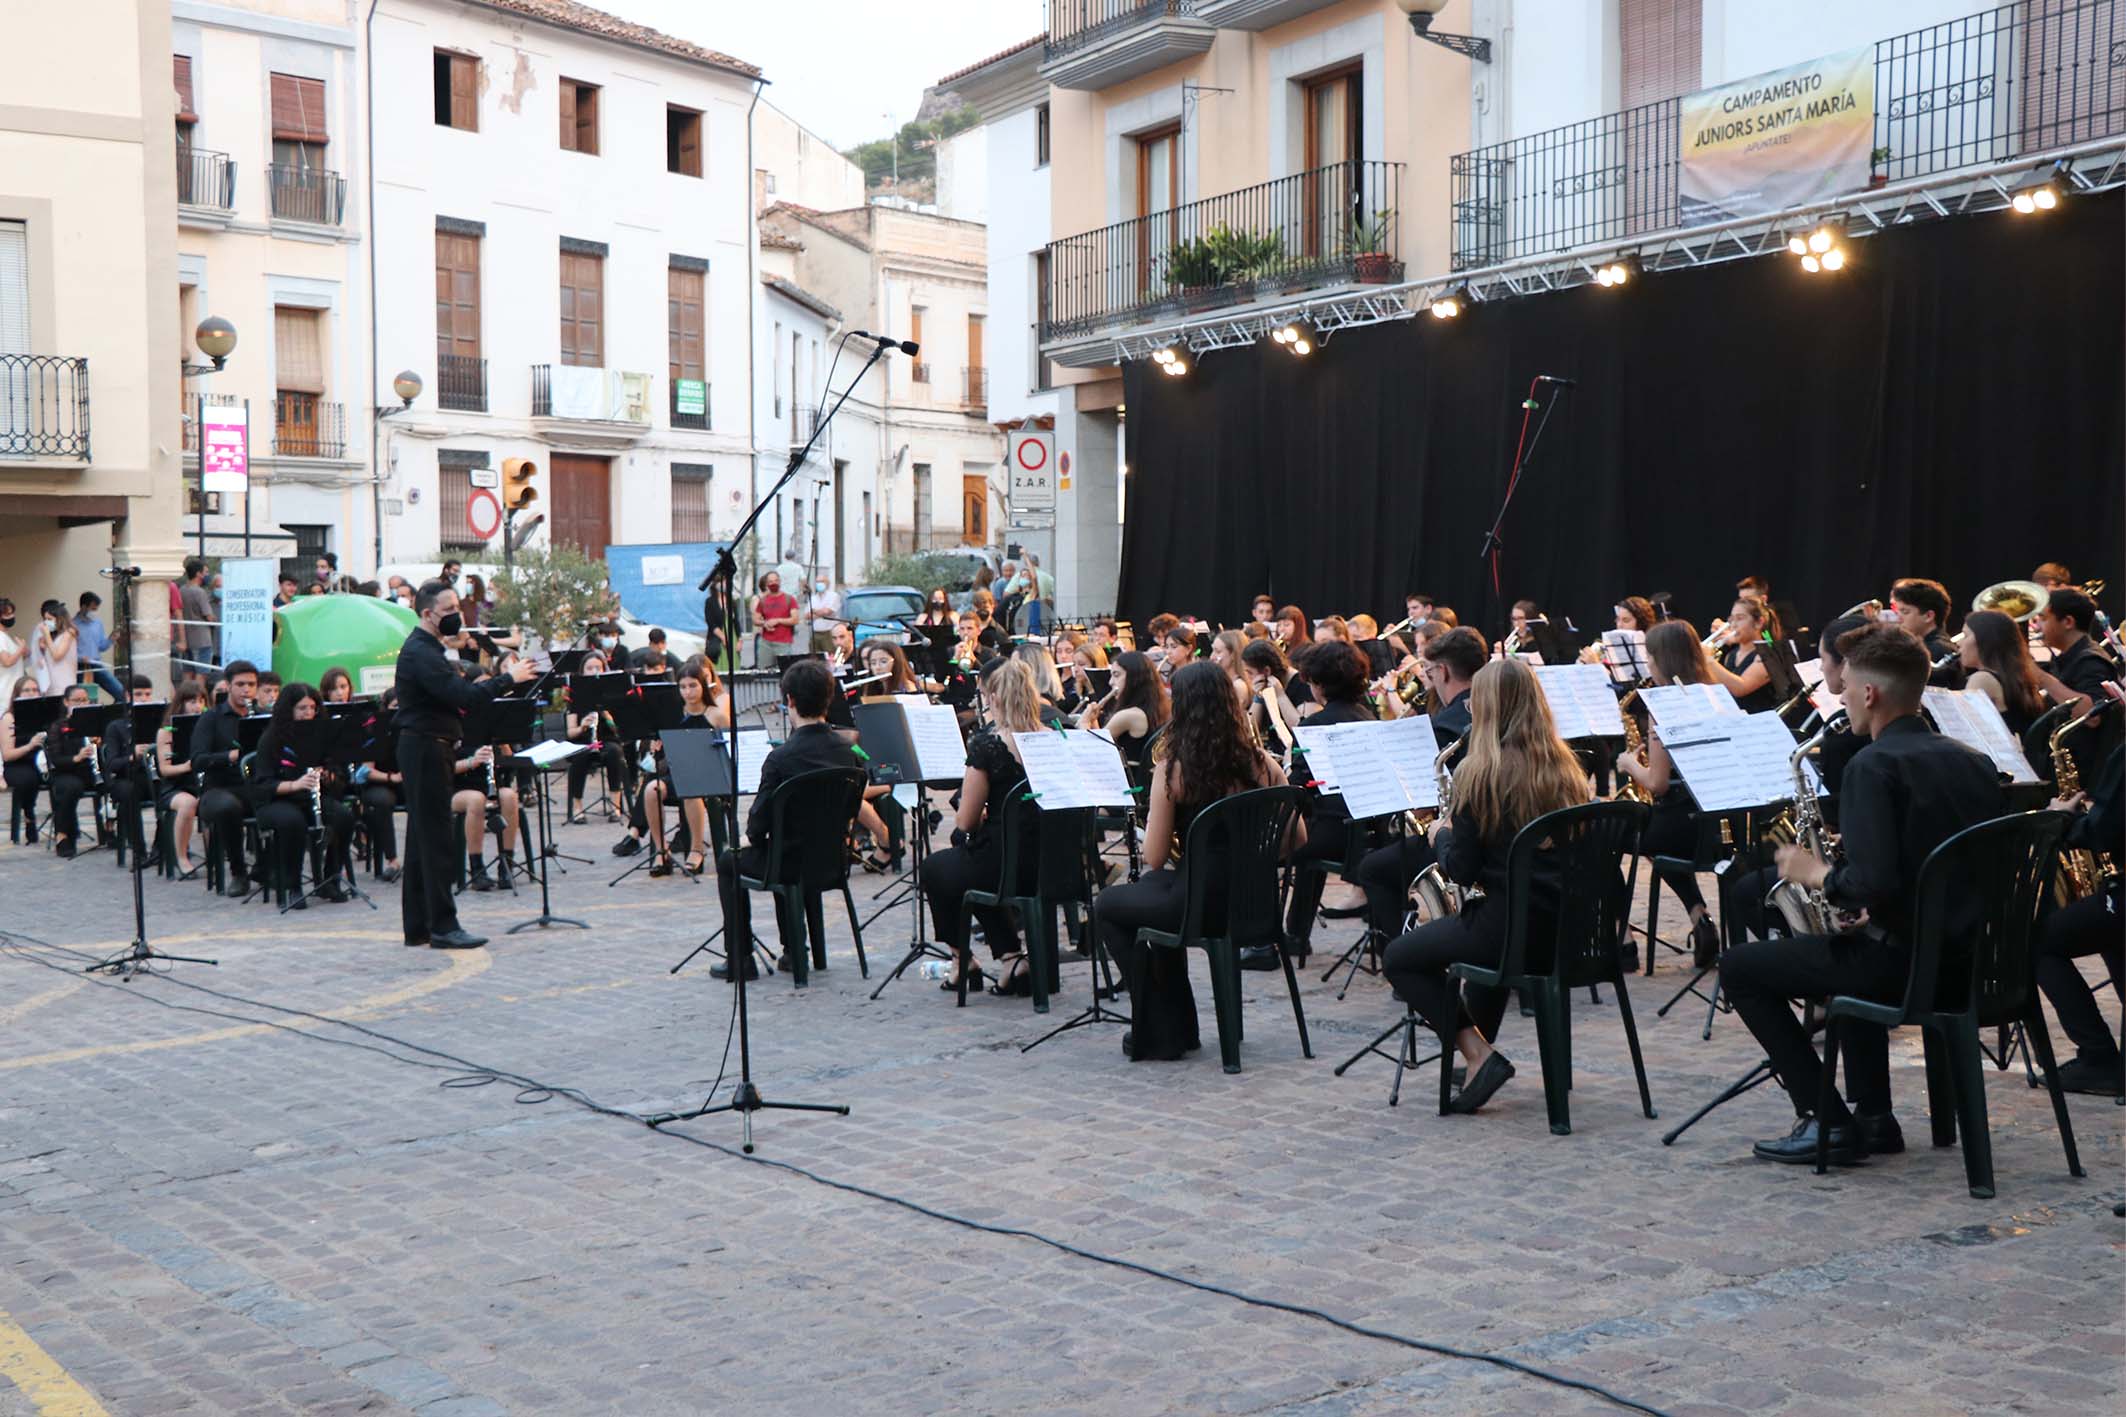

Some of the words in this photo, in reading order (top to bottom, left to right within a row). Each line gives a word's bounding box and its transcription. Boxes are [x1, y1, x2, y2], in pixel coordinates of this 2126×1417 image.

[1723, 73, 1822, 113] CAMPAMENTO
[1695, 120, 1753, 148] JUNIORS
[1757, 106, 1803, 133] SANTA
[1805, 88, 1856, 120] MARÍA
[225, 600, 267, 611] PROFESSIONAL
[226, 613, 236, 624] DE
